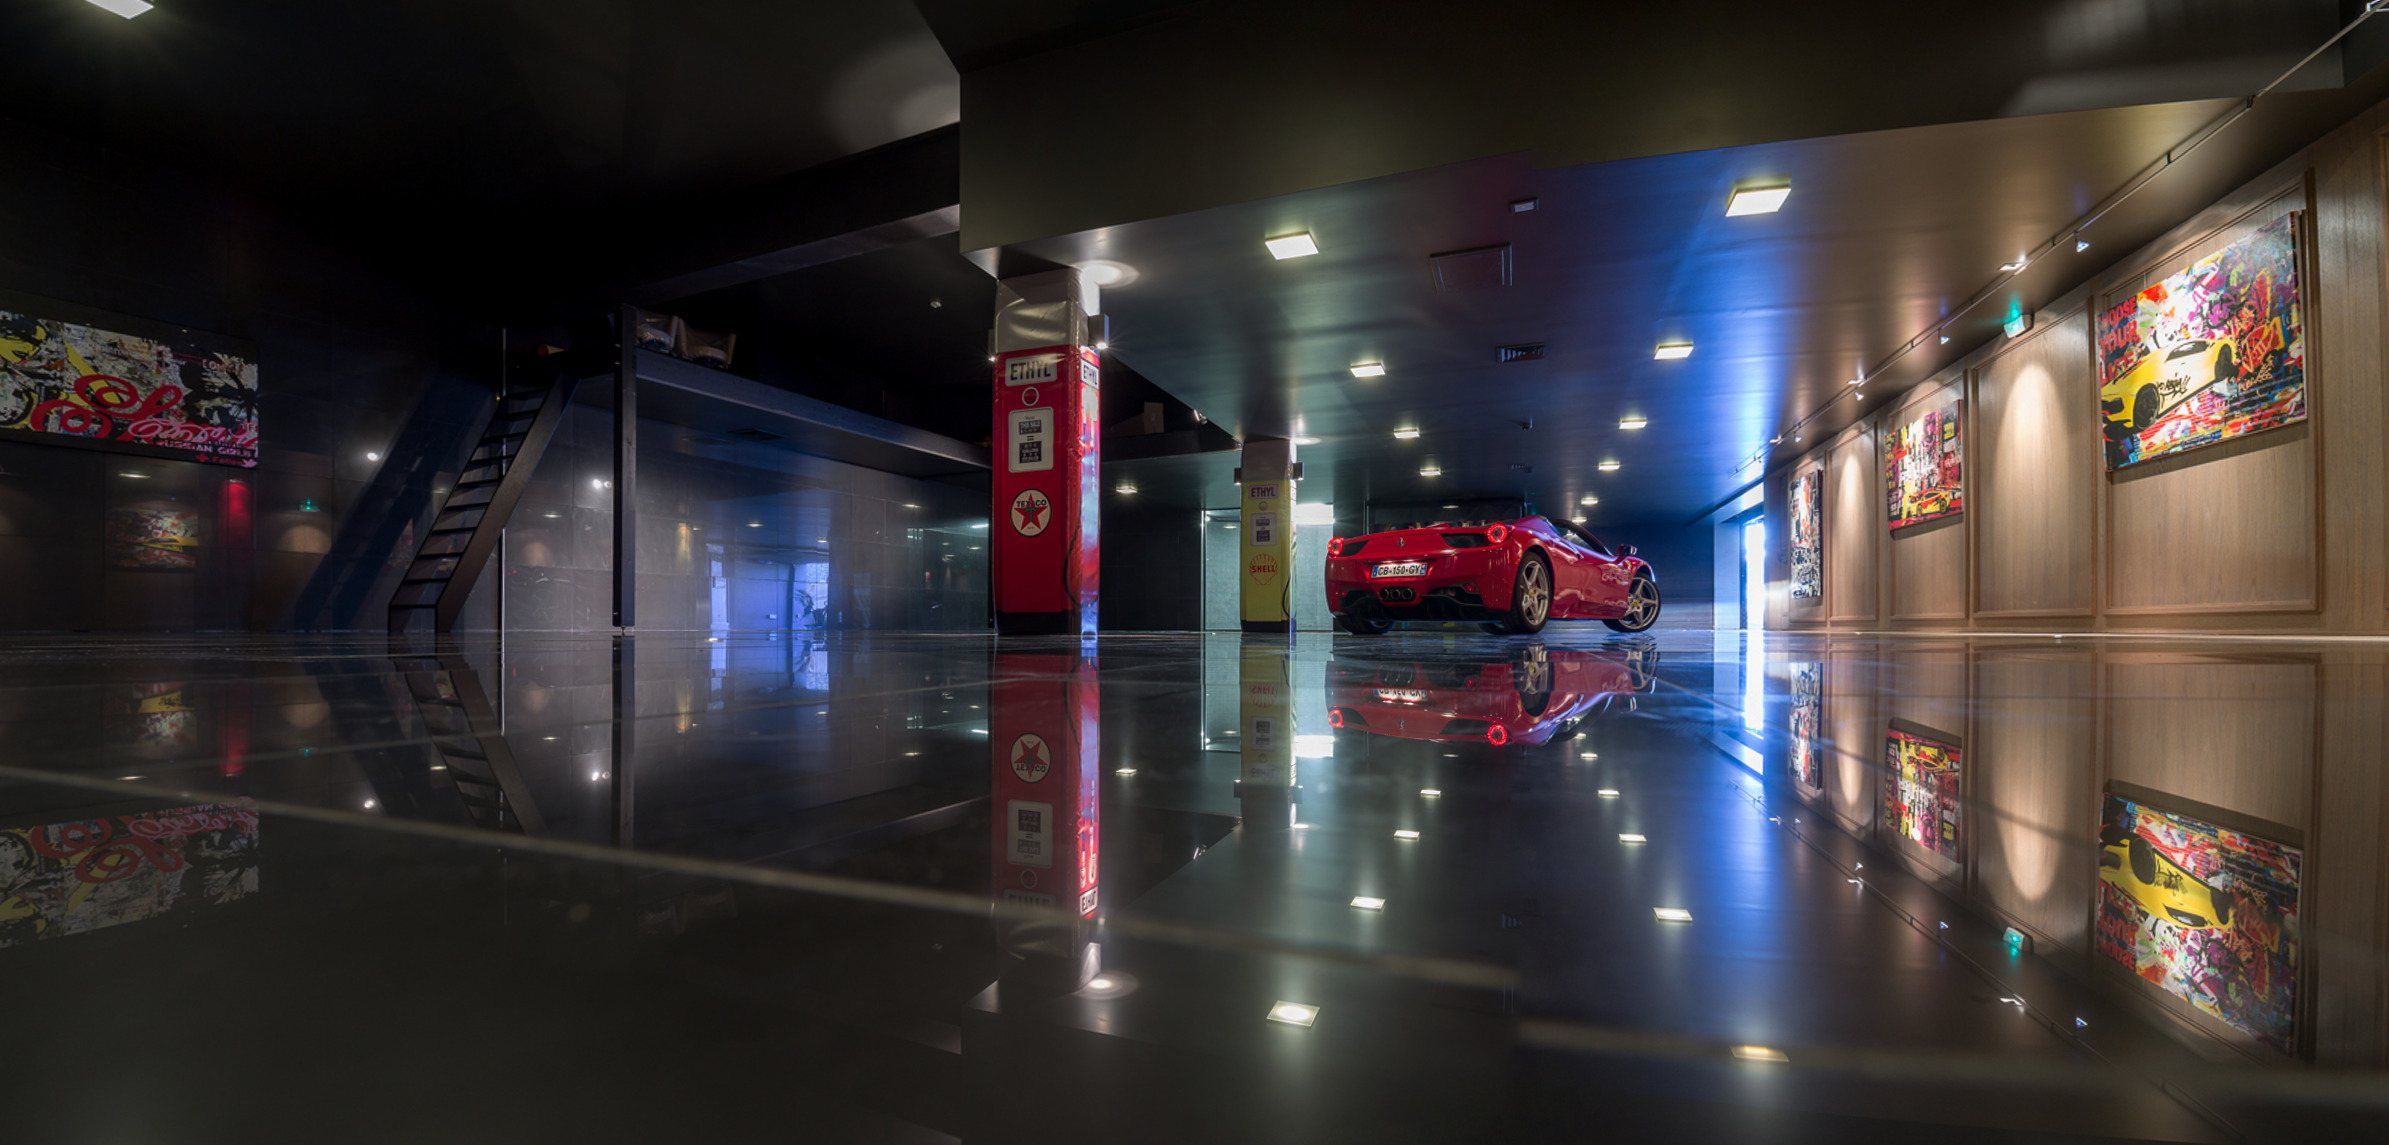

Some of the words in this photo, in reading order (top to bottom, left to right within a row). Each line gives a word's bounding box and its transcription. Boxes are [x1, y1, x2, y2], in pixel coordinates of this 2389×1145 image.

[1010, 362, 1052, 380] ETHYL
[1251, 486, 1276, 498] ETHYL
[1251, 565, 1276, 573] SHELL
[1378, 564, 1420, 576] CB-150-GY
